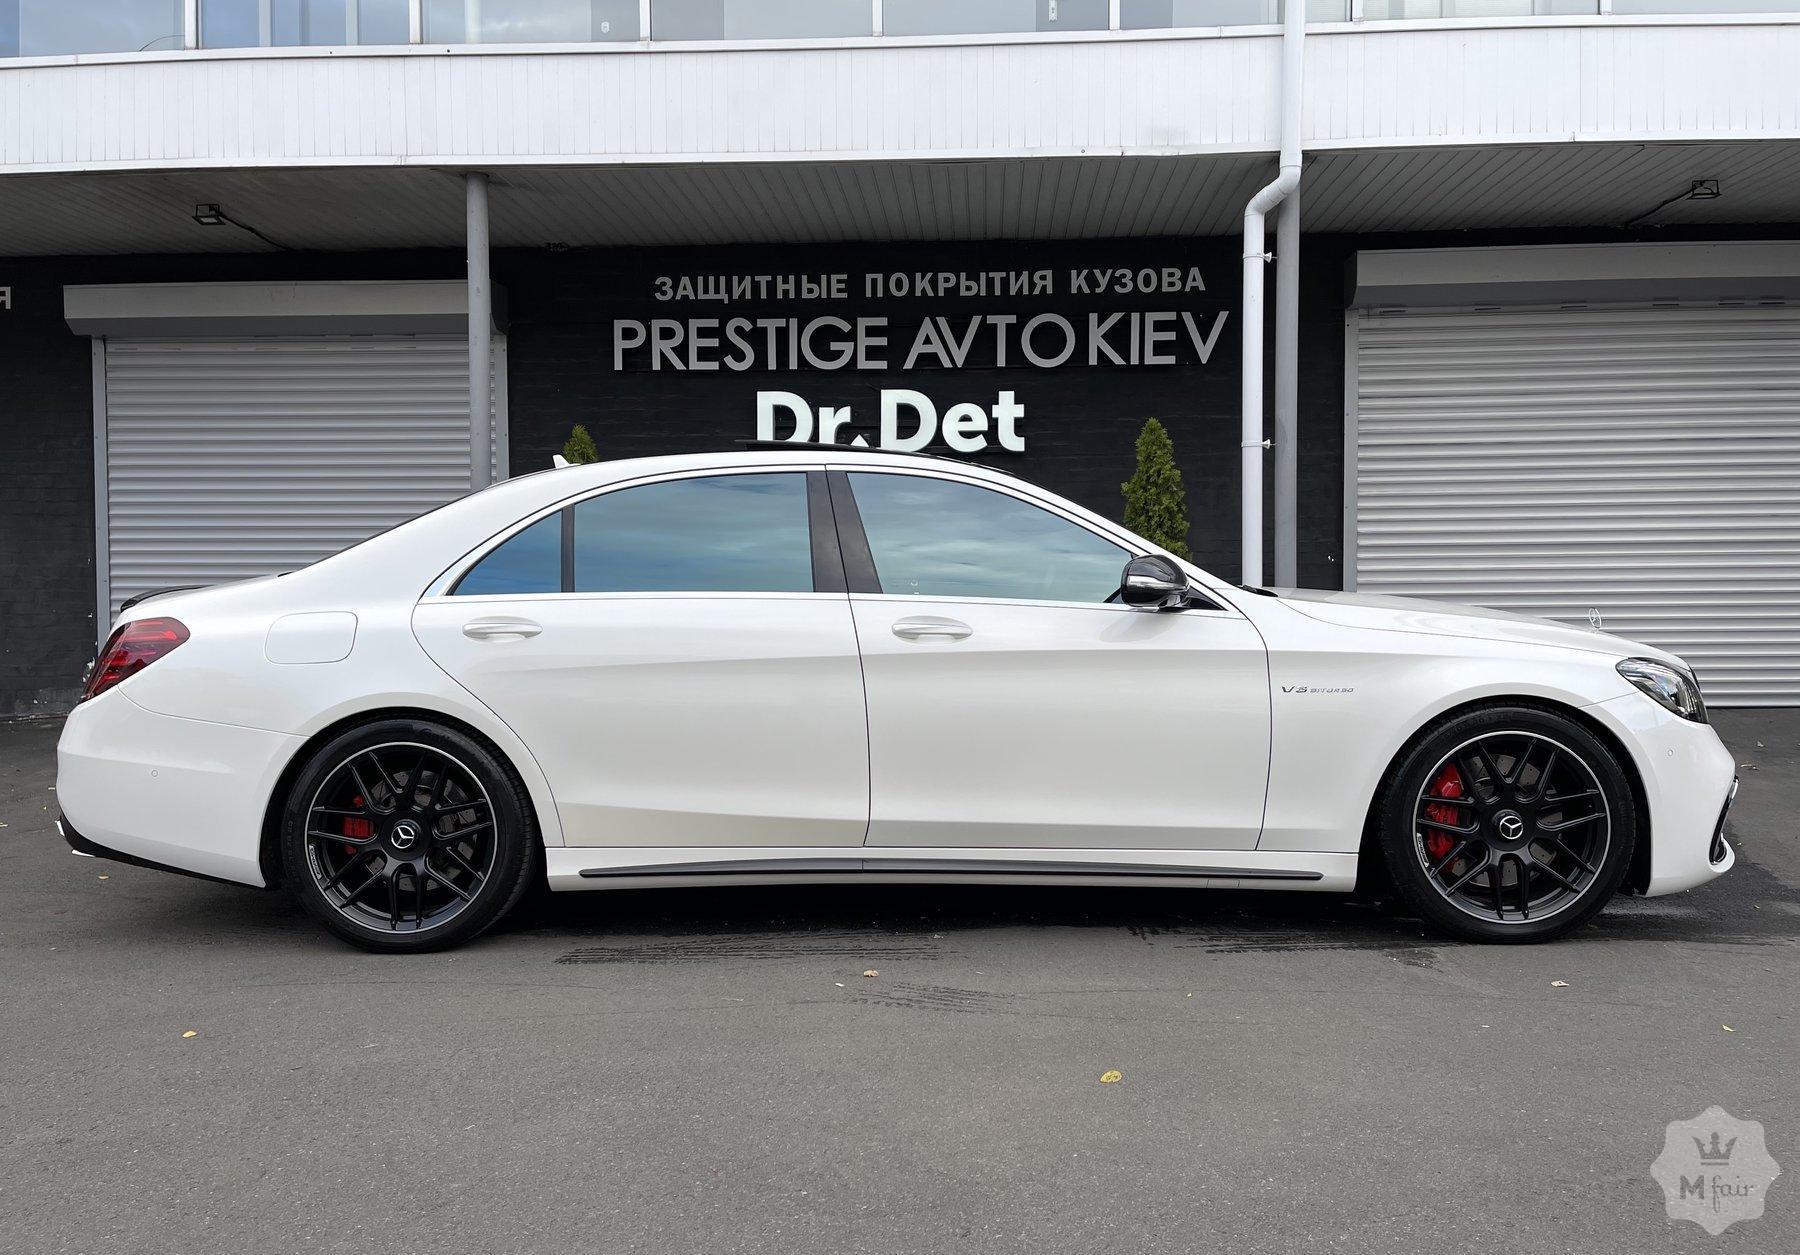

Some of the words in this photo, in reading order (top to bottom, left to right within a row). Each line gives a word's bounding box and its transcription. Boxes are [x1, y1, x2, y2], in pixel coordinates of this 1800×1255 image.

[654, 275, 848, 303] ЗАЩИТНЫЕ
[865, 270, 1053, 297] ПОКРЫТИЯ
[1070, 267, 1206, 294] КУЗОВА
[613, 315, 888, 372] PRESTIGE
